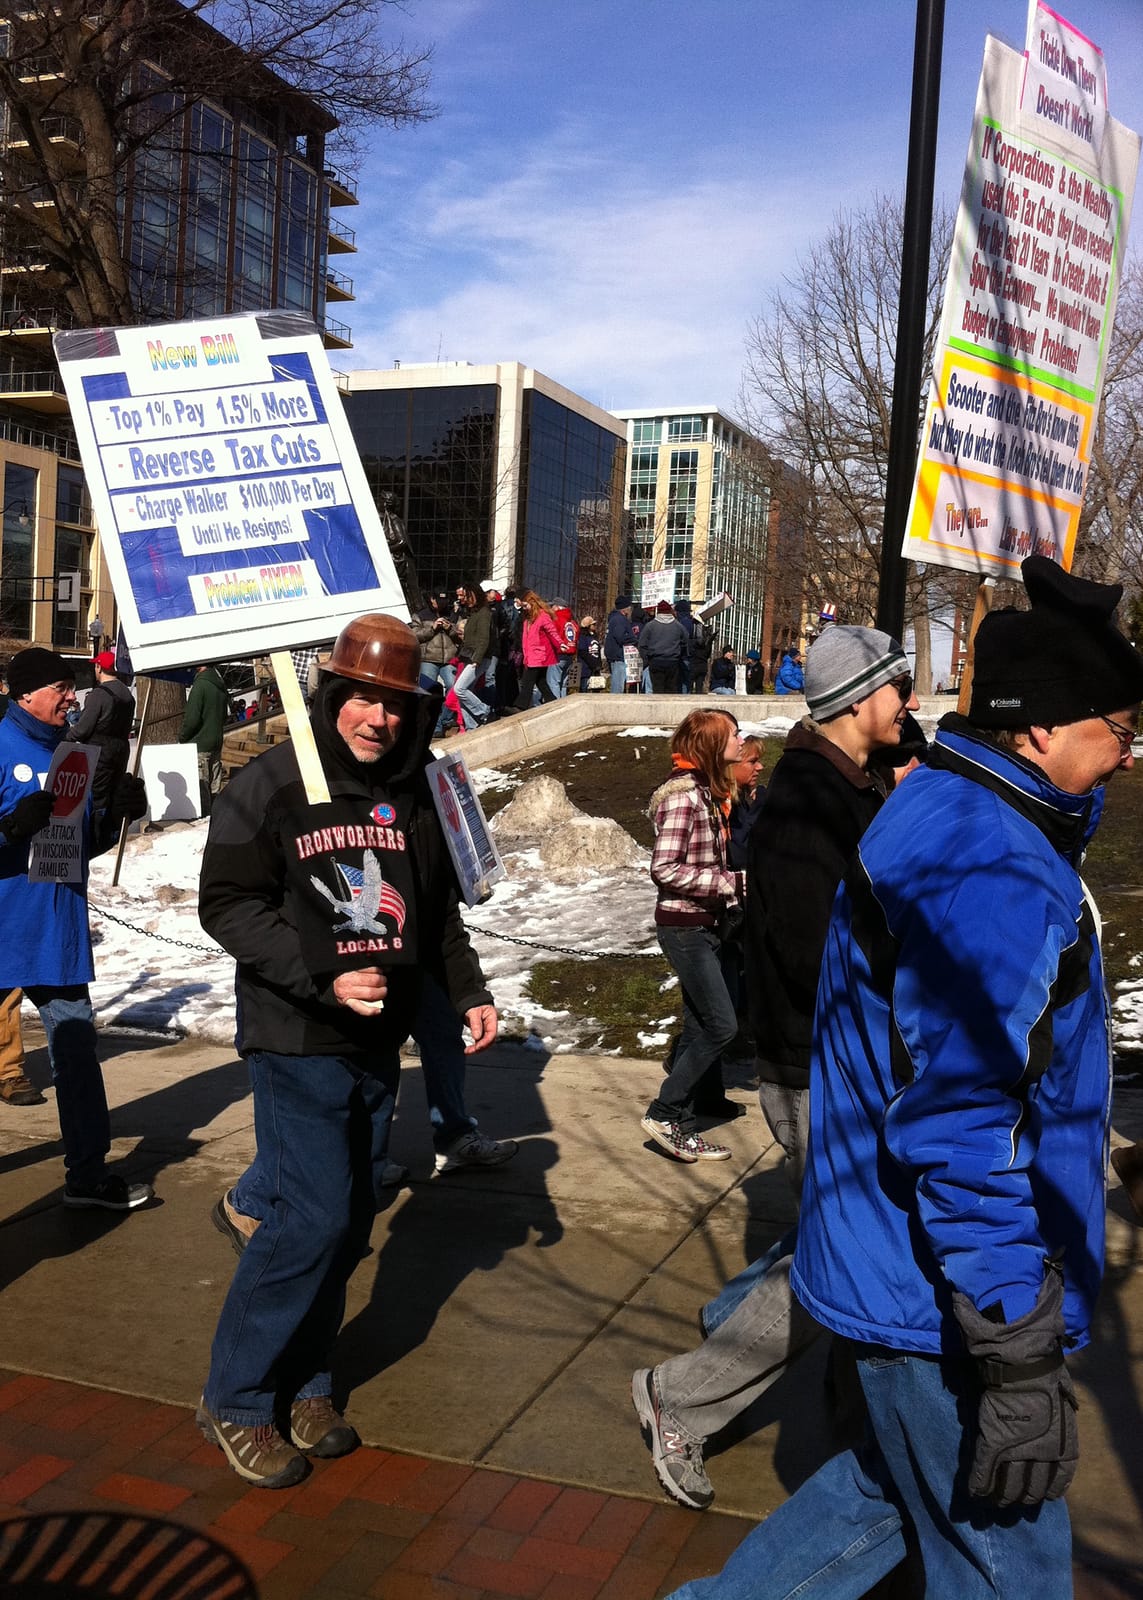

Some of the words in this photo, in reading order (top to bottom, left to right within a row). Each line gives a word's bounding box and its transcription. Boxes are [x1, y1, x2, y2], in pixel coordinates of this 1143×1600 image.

[1036, 84, 1070, 130] Doesn't
[1071, 104, 1094, 143] Work!
[982, 126, 994, 159] If
[993, 131, 1054, 189] Corporations
[1059, 166, 1066, 194] &
[1068, 171, 1082, 203] the
[1083, 179, 1113, 229] Wealthy
[982, 178, 1006, 214] used
[1005, 181, 1019, 220] the
[1020, 188, 1037, 228] Tax
[1037, 196, 1055, 237] Cuts
[1057, 208, 1073, 250] they
[1072, 215, 1087, 251] have
[976, 214, 990, 251] for
[989, 219, 1003, 257] the
[1003, 225, 1020, 264] last
[1018, 232, 1030, 268] 20
[1030, 236, 1050, 277] Years
[1052, 247, 1061, 283] to
[1062, 250, 1085, 295] Create
[1085, 263, 1101, 303] Jobs
[970, 252, 990, 296] Spur
[989, 260, 1003, 296] the
[1046, 287, 1057, 320] We
[1058, 300, 1087, 334] wouldn't
[1085, 307, 1100, 341] have
[147, 340, 198, 371] New
[200, 333, 240, 366] Bill
[962, 300, 990, 343] Budget
[989, 318, 998, 340] or
[997, 312, 1037, 356] Employment
[1040, 328, 1081, 374] Problems!
[146, 400, 172, 426] 1%
[174, 399, 205, 428] Pay
[216, 393, 261, 425] 1.5%
[262, 391, 308, 420] More
[947, 372, 987, 415] Scooter
[987, 390, 1007, 422] and
[1006, 390, 1020, 426] the
[1051, 407, 1069, 444] know
[128, 447, 215, 480] Reverse
[224, 438, 269, 471] Tax
[271, 433, 321, 466] Cuts
[928, 413, 946, 451] but
[944, 419, 963, 463] they
[963, 424, 974, 459] do
[974, 429, 994, 464] what
[993, 432, 1006, 469] the
[1006, 435, 1025, 473] Koch
[1039, 448, 1053, 484] tell
[1051, 451, 1066, 489] them
[1065, 460, 1073, 491] to
[183, 488, 228, 515] Walker
[239, 480, 292, 511] $100,000
[291, 477, 312, 502] Per
[312, 477, 337, 505] Day
[192, 522, 222, 546] Until
[224, 522, 241, 540] He
[242, 515, 293, 543] Resigns!
[946, 503, 966, 538] They
[203, 572, 257, 608] Problem
[259, 564, 308, 601] FIXED!
[54, 770, 87, 797] STOP
[42, 843, 80, 860] WISCONSIN
[51, 825, 76, 840] ATTACK
[295, 825, 406, 860] IRONWORKERS
[39, 862, 69, 877] FAMILIES
[336, 938, 388, 954] LOCAL
[393, 937, 402, 950] 8
